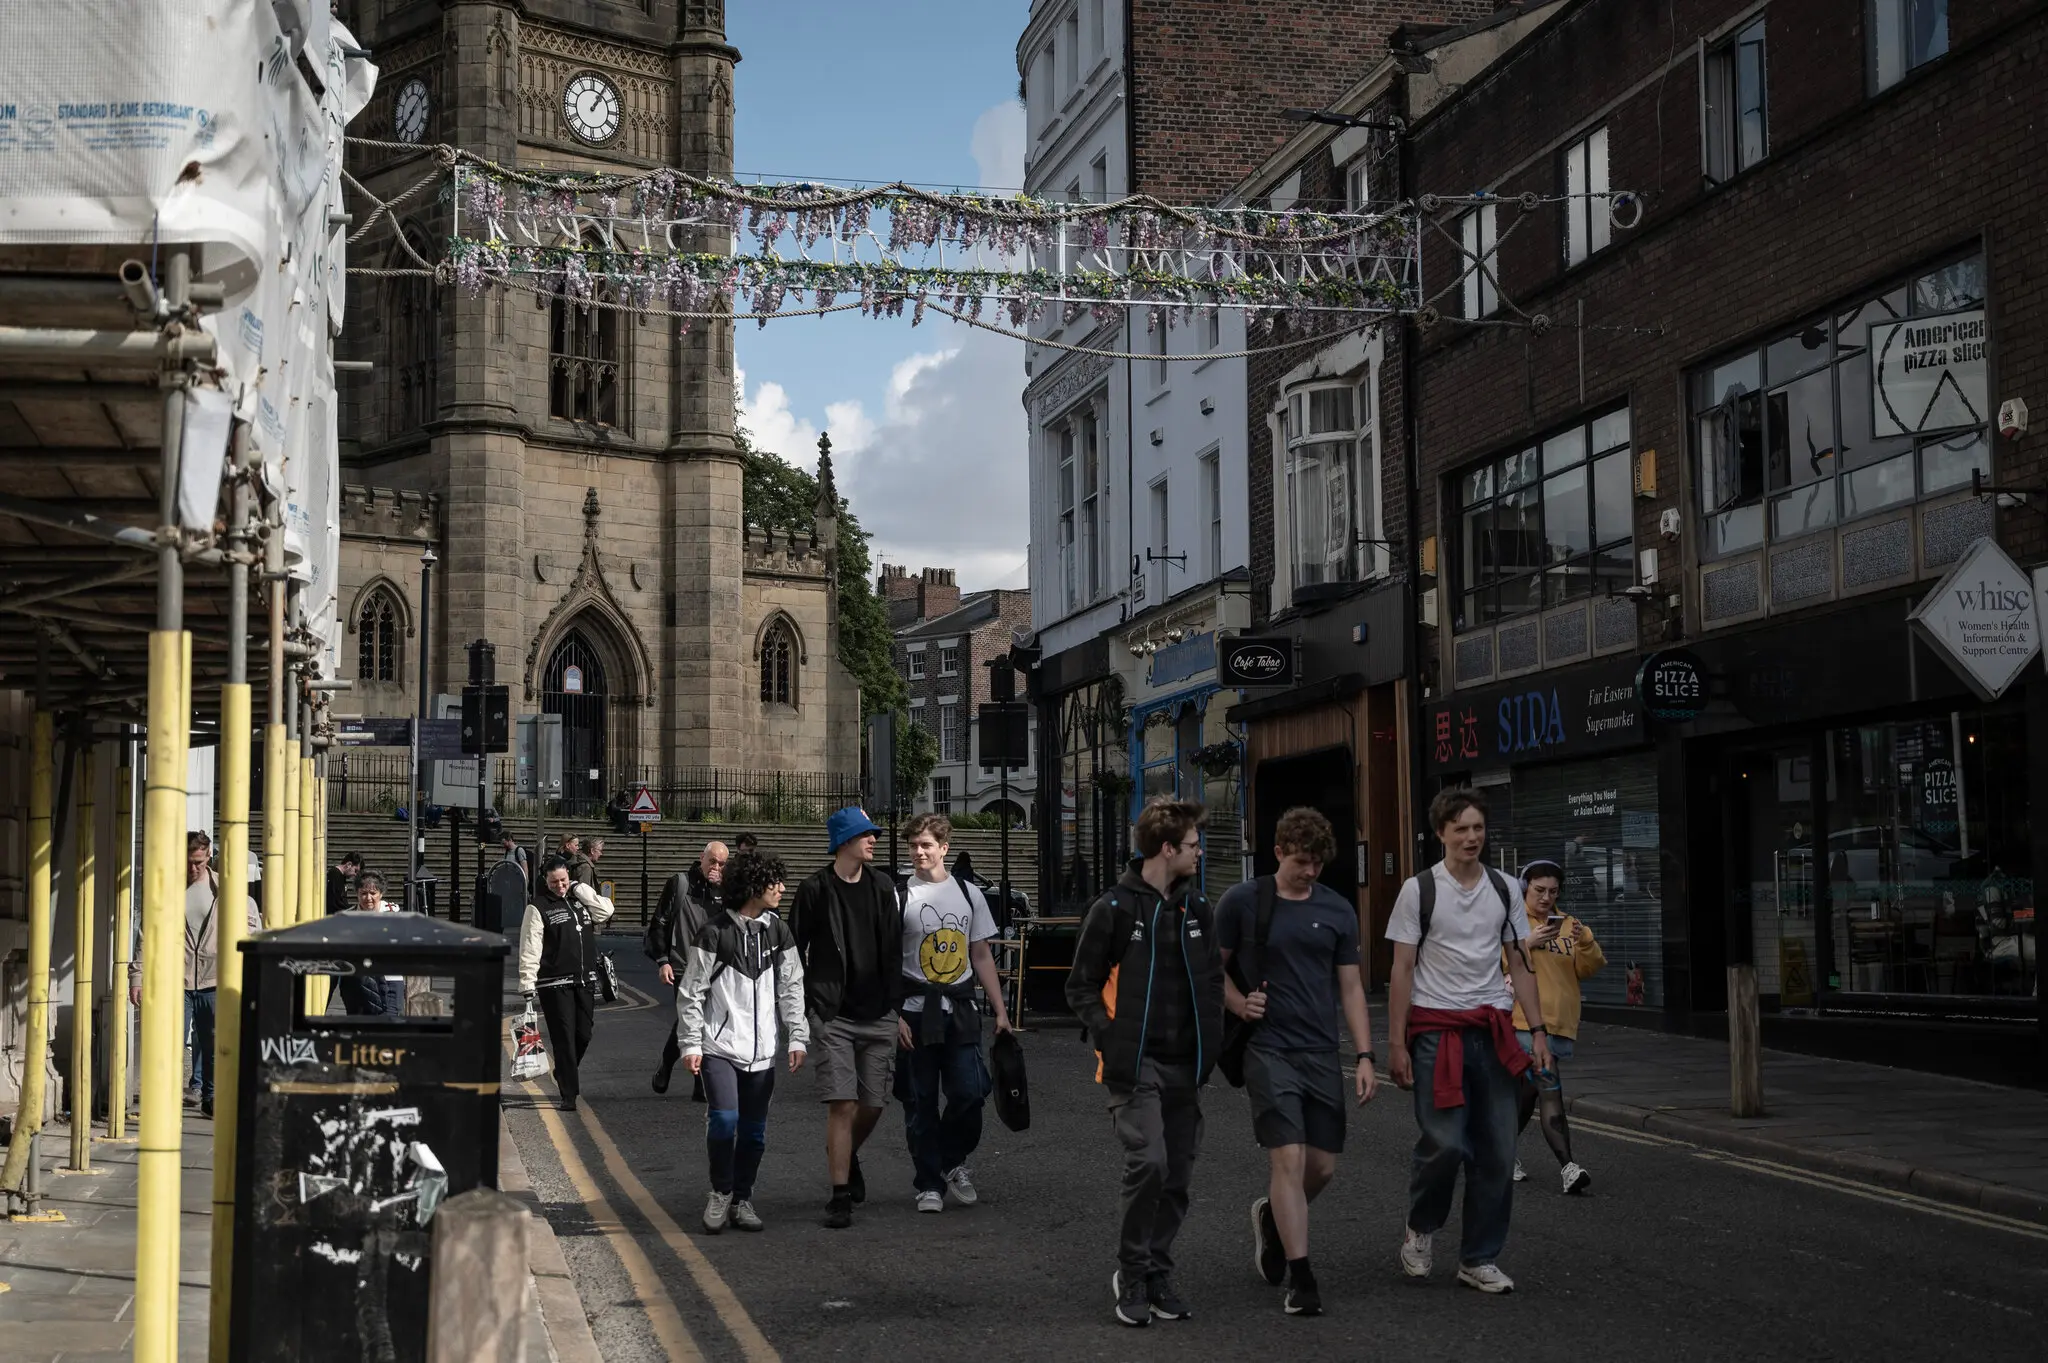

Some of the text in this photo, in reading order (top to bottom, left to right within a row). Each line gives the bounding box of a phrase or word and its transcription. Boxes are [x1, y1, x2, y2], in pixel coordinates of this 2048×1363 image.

[58, 102, 193, 120] STANDARD FLAME RETARDANT
[1904, 349, 1947, 374] pizza
[1955, 581, 2030, 612] whisc
[1958, 621, 2030, 631] Women's Health
[1963, 633, 2026, 643] Information &
[1962, 646, 2029, 658] Support Centre
[1256, 655, 1281, 668] Tabac
[1660, 660, 1693, 670] AMERICAN
[1654, 670, 1699, 684] PIZZA
[1588, 686, 1633, 706] Far Eastern
[1655, 684, 1700, 697] SLICE
[1497, 685, 1566, 754] SIDA
[1586, 710, 1634, 737] Supermarket
[1435, 705, 1480, 763] 思达
[1925, 770, 1957, 787] PIZZA
[1568, 788, 1617, 805] Everything You Need
[1926, 788, 1957, 804] SLICE
[1580, 806, 1593, 816] Asian
[1594, 803, 1615, 816] Cooking!
[1540, 937, 1573, 956] AP
[334, 1044, 406, 1066] Litter
